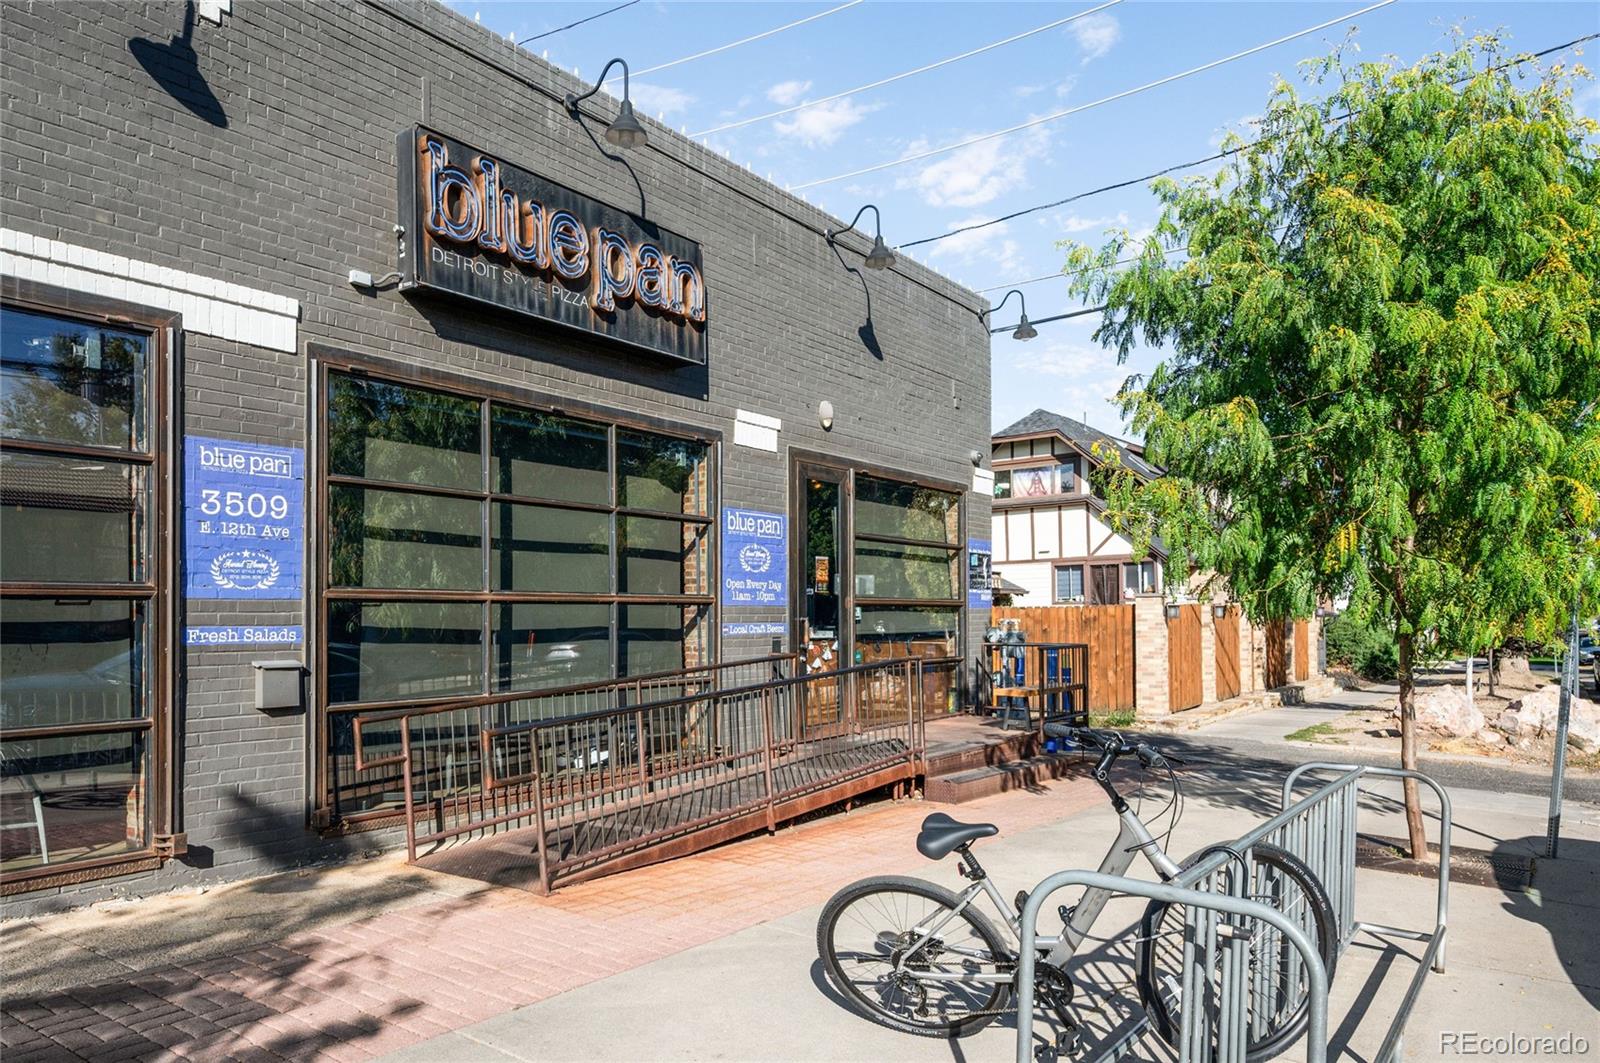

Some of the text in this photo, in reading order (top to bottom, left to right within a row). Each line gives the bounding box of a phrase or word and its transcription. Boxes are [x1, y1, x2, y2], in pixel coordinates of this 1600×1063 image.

[421, 134, 706, 322] blue pan
[432, 246, 589, 309] DETROIT STYE PIZZA
[199, 445, 246, 469] blue
[249, 456, 288, 475] pan
[200, 489, 288, 520] 3509
[199, 521, 290, 538] E. 12th Ave
[727, 510, 780, 537] blue pan
[726, 578, 782, 592] Open Every Day
[731, 590, 751, 601] 11am
[755, 590, 776, 602] 10pm
[187, 628, 297, 643] Fresh Salads
[729, 624, 785, 634] Local Craft Beers
